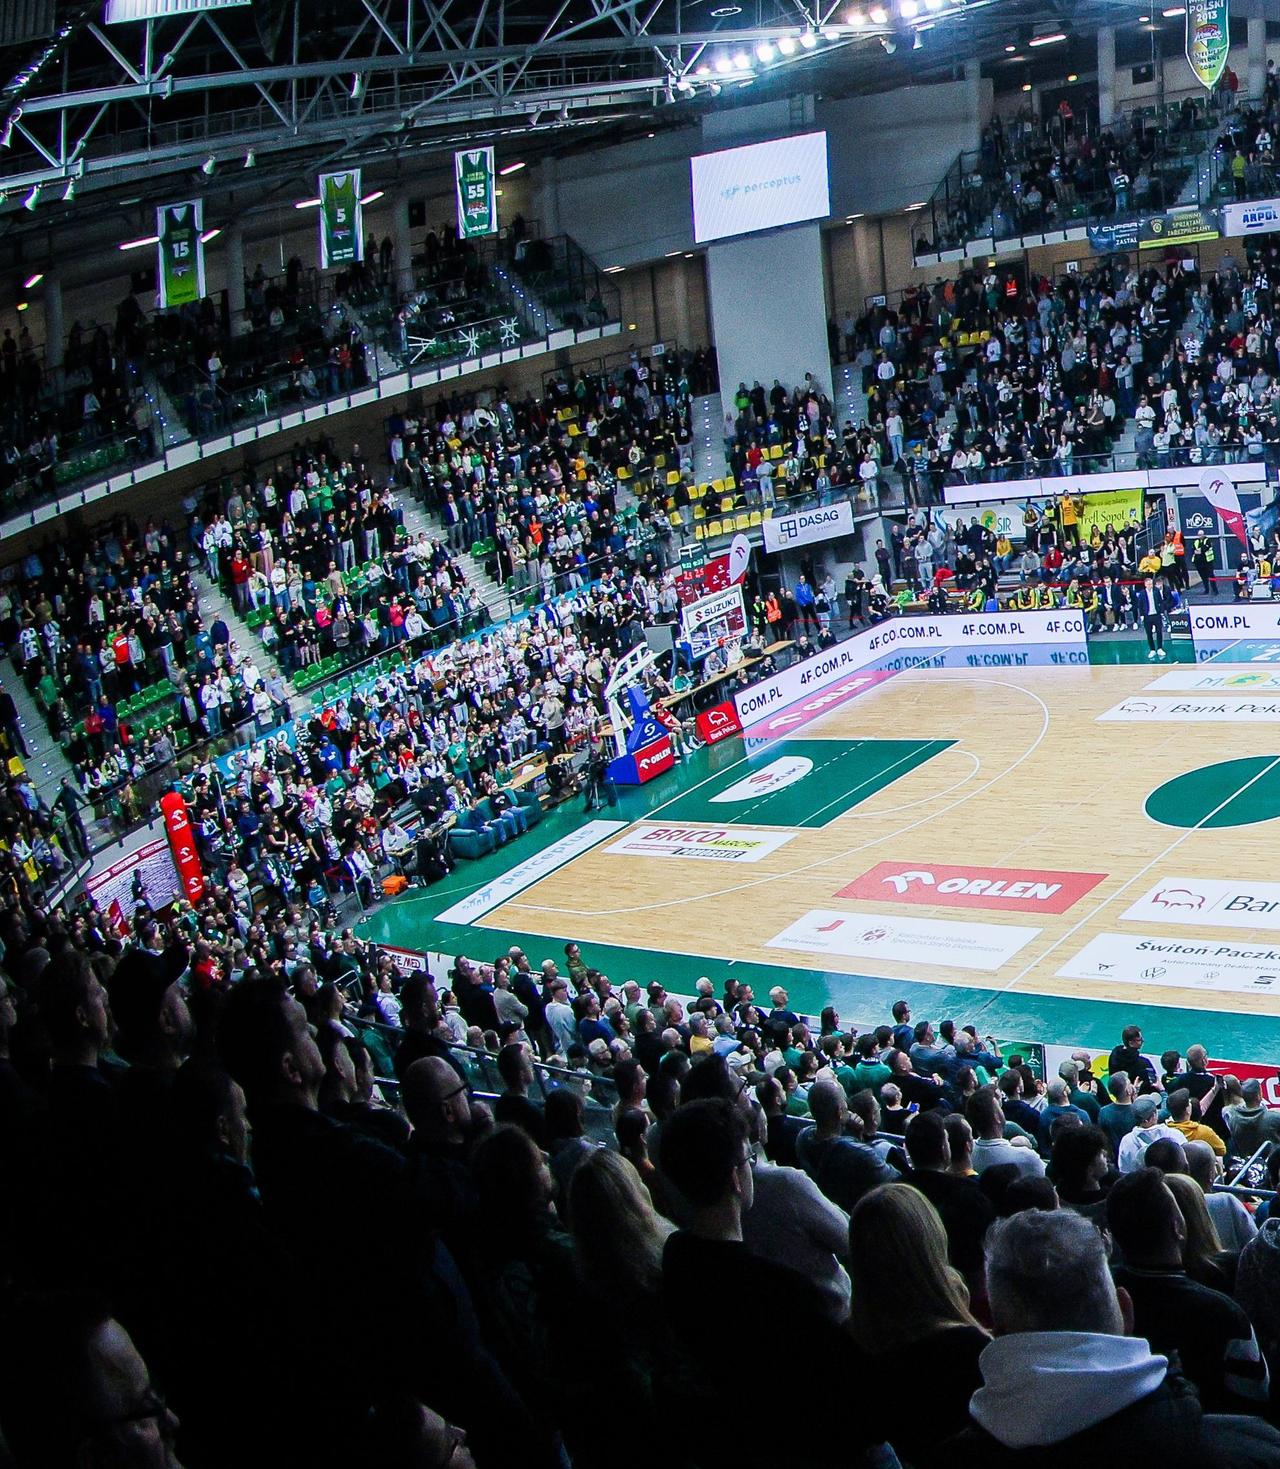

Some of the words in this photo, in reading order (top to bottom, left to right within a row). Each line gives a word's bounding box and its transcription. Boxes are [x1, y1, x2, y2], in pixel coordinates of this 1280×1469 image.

[1196, 11, 1218, 21] 2013
[468, 183, 485, 199] 55
[336, 208, 346, 223] 5
[1242, 210, 1279, 223] ARPOL
[174, 243, 189, 258] 15
[799, 509, 840, 528] DASAG
[1100, 509, 1125, 524] Sopot
[704, 596, 737, 617] SUZUKI
[961, 621, 1025, 636] 4F.COM.PL
[799, 651, 854, 686] 4F.COM.PL
[1169, 704, 1229, 714] Bank
[650, 747, 671, 765] ORLEN
[642, 829, 728, 843] BRICO
[499, 828, 596, 886] perceptus
[937, 877, 1063, 901] ORLEN
